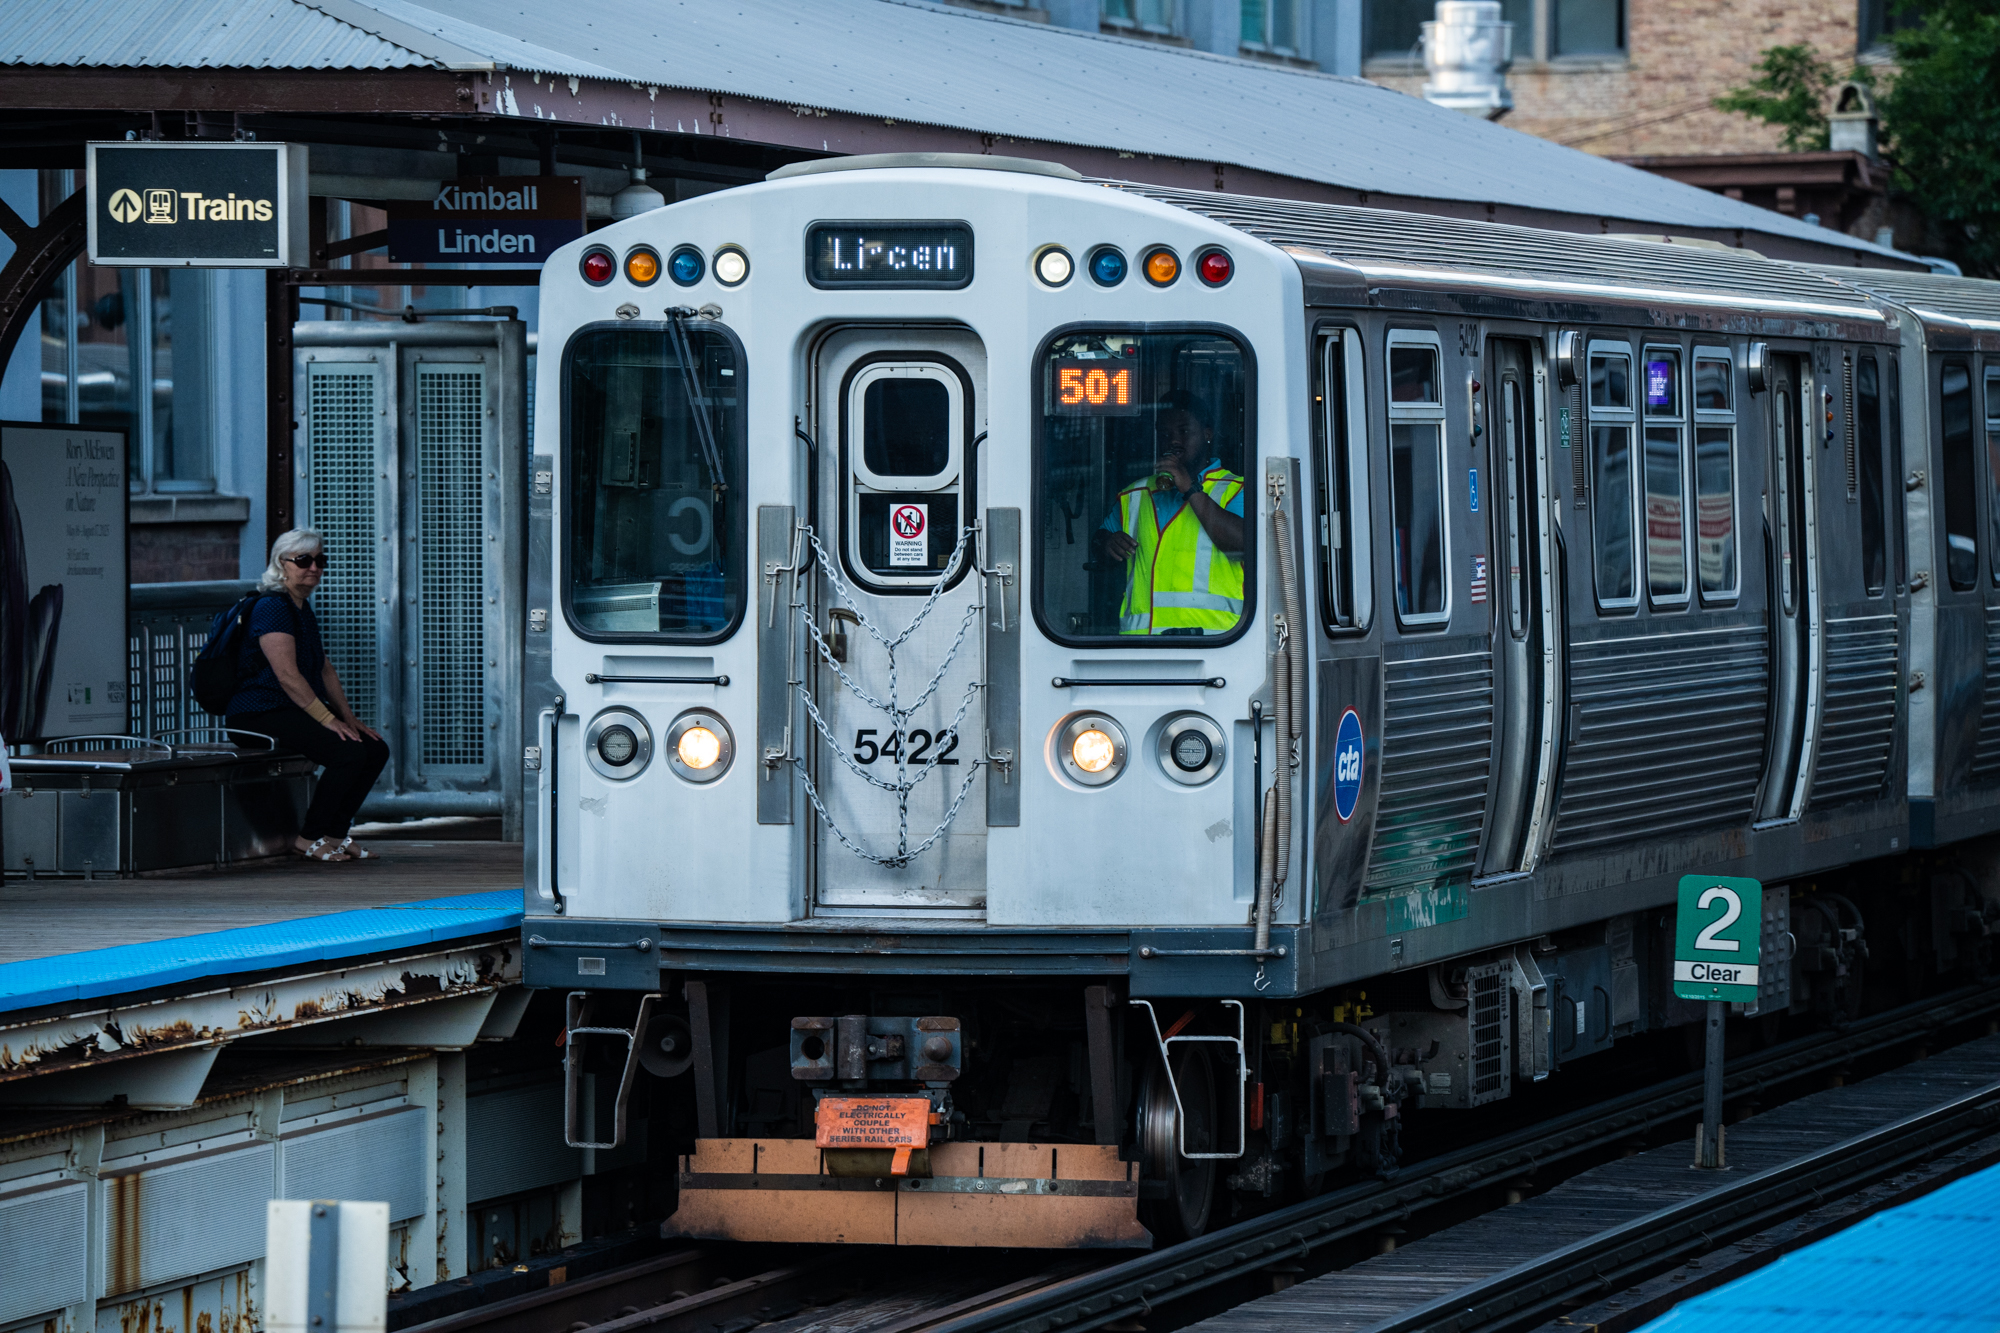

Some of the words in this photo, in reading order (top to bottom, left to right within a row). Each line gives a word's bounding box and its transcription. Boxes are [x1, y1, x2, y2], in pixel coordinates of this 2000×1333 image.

[180, 192, 273, 222] Trains
[433, 185, 538, 211] Kimball
[438, 228, 536, 254] Linden
[1459, 323, 1479, 357] 5422
[1060, 368, 1129, 404] 501
[853, 728, 960, 766] 5422
[1337, 744, 1360, 782] cta
[1693, 885, 1743, 953] 2
[1690, 963, 1742, 982] Clear
[839, 1111, 907, 1119] ELECTRICALLY
[829, 1135, 862, 1143] SERIES
[864, 1135, 885, 1143] RAIL
[869, 1127, 900, 1135] OTHER
